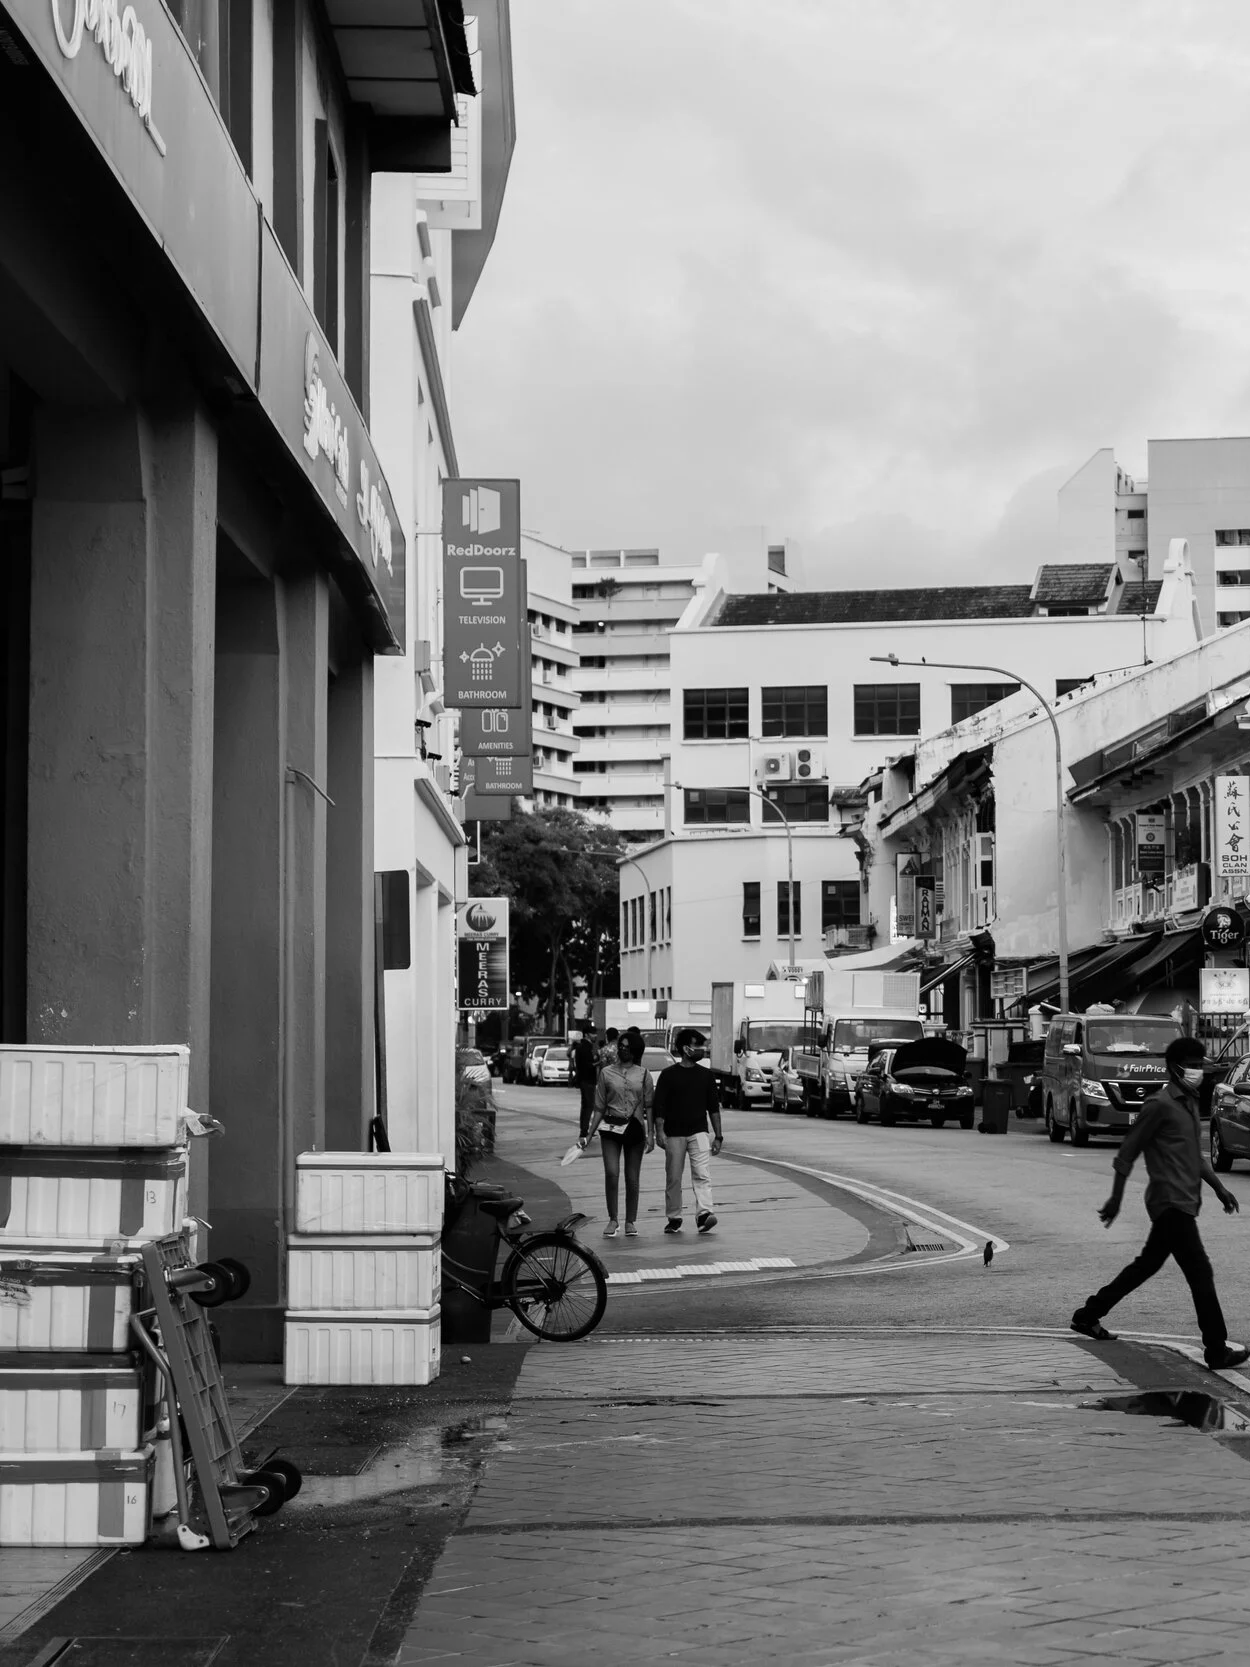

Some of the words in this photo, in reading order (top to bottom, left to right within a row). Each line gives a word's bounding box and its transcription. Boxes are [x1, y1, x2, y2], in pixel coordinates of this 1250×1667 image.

[446, 543, 516, 556] RedDoorz
[458, 615, 506, 624] TELEVISION
[458, 690, 507, 699] BATHROOM
[478, 741, 514, 750] AMENITIES
[485, 782, 523, 790] BATHROOM
[1221, 854, 1248, 862] SOH
[920, 889, 930, 931] RAHMAN
[1209, 928, 1240, 945] Tiger
[476, 942, 490, 998] MEERAS
[464, 997, 502, 1006] CURRY
[1129, 1063, 1167, 1073] FairPrice
[145, 1190, 157, 1204] 13
[112, 1400, 127, 1417] 17
[126, 1494, 138, 1505] 16
